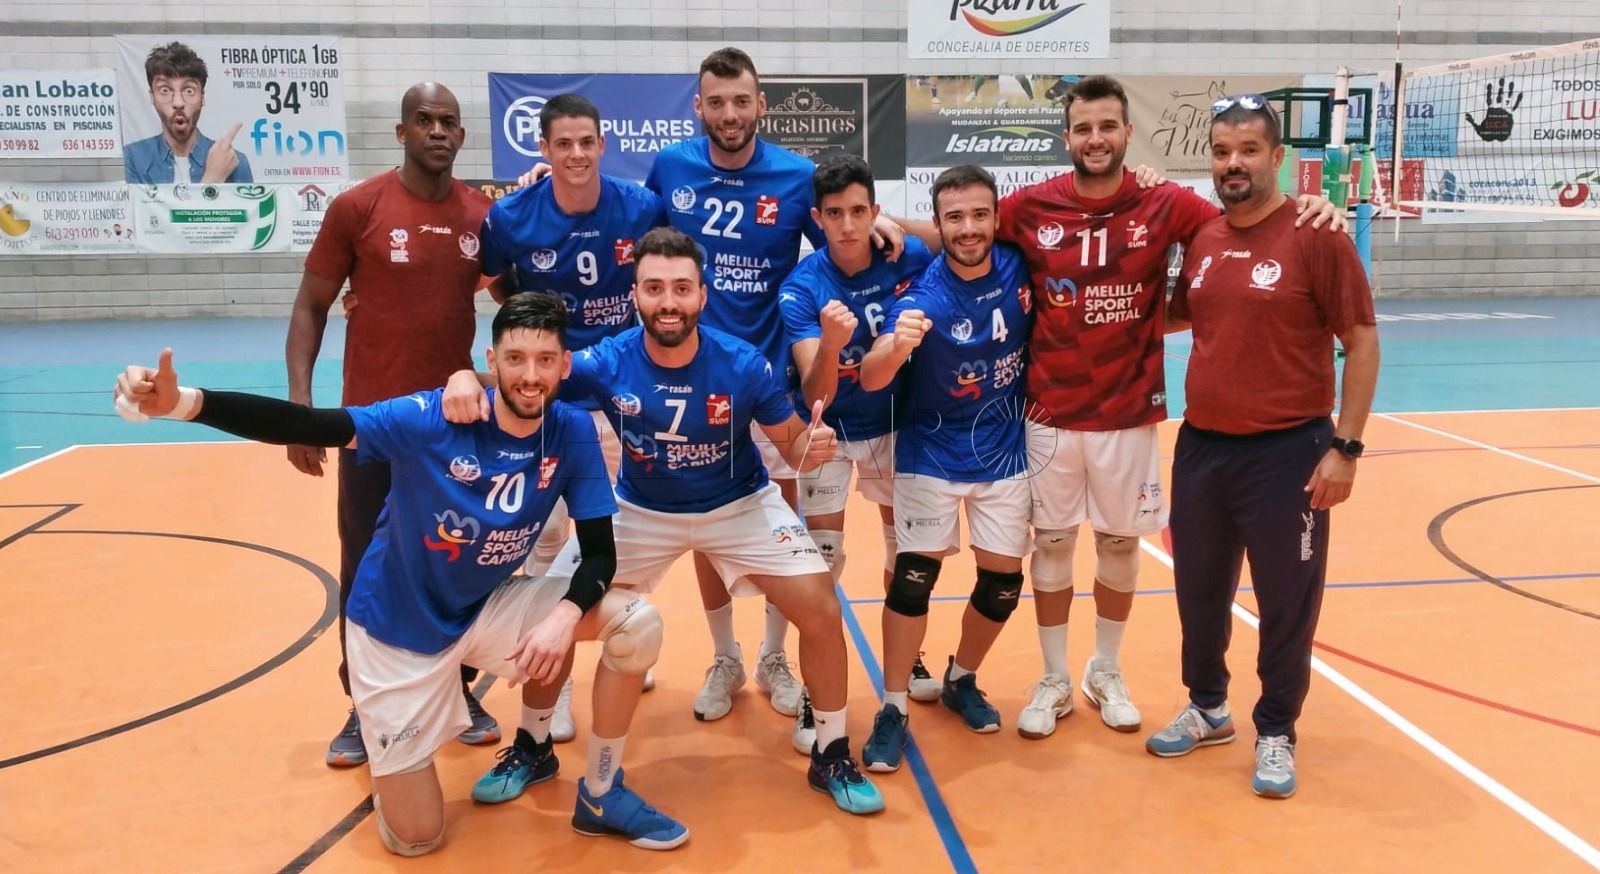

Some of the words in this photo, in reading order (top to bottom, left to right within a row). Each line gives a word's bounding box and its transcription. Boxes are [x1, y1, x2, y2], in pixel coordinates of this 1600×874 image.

[221, 48, 258, 64] FIBRA
[262, 45, 307, 64] ÓPTICA
[312, 43, 338, 64] 1GB
[927, 41, 1001, 53] CONCEJALIA
[1005, 41, 1022, 53] DE
[1026, 41, 1090, 53] DEPORTES
[36, 79, 114, 98] Lobato
[233, 81, 245, 89] POR
[246, 81, 262, 89] SOLO
[6, 104, 20, 117] DE
[26, 100, 115, 117] CONSTRUCCIÓN
[939, 107, 982, 117] Apoyando
[984, 107, 993, 115] el
[994, 106, 1027, 117] deporte
[1028, 107, 1039, 115] en
[53, 121, 66, 131] EN
[73, 121, 113, 131] PISCINAS
[1000, 118, 1062, 126] GUARDAMUEBLES
[62, 139, 79, 151] 636
[81, 139, 97, 151] 143
[98, 139, 115, 151] 559
[250, 118, 345, 157] fion
[945, 133, 1054, 153] Islatrans
[283, 168, 291, 176] EN
[37, 190, 67, 203] CENTRO
[69, 190, 79, 202] DE
[43, 209, 54, 221] DE
[55, 208, 81, 222] PIOJOS
[82, 209, 88, 221] Y
[89, 208, 126, 220] LIENDRES
[701, 197, 744, 240] 22
[81, 227, 99, 239] 010
[1076, 227, 1108, 267] 11
[576, 250, 599, 286] 9
[714, 252, 772, 269] MELILLA
[714, 265, 761, 281] SPORT
[1085, 282, 1143, 298] MELILLA
[583, 303, 629, 319] SPORT
[1085, 296, 1134, 312] SPORT
[864, 302, 886, 338] 6
[1084, 307, 1142, 325] CAPITAL
[992, 307, 1008, 343] 4
[654, 399, 689, 442] 7
[666, 448, 718, 464] SPORT
[485, 471, 526, 513] 10
[486, 521, 541, 542] MELILLA
[481, 537, 531, 554] SPORT
